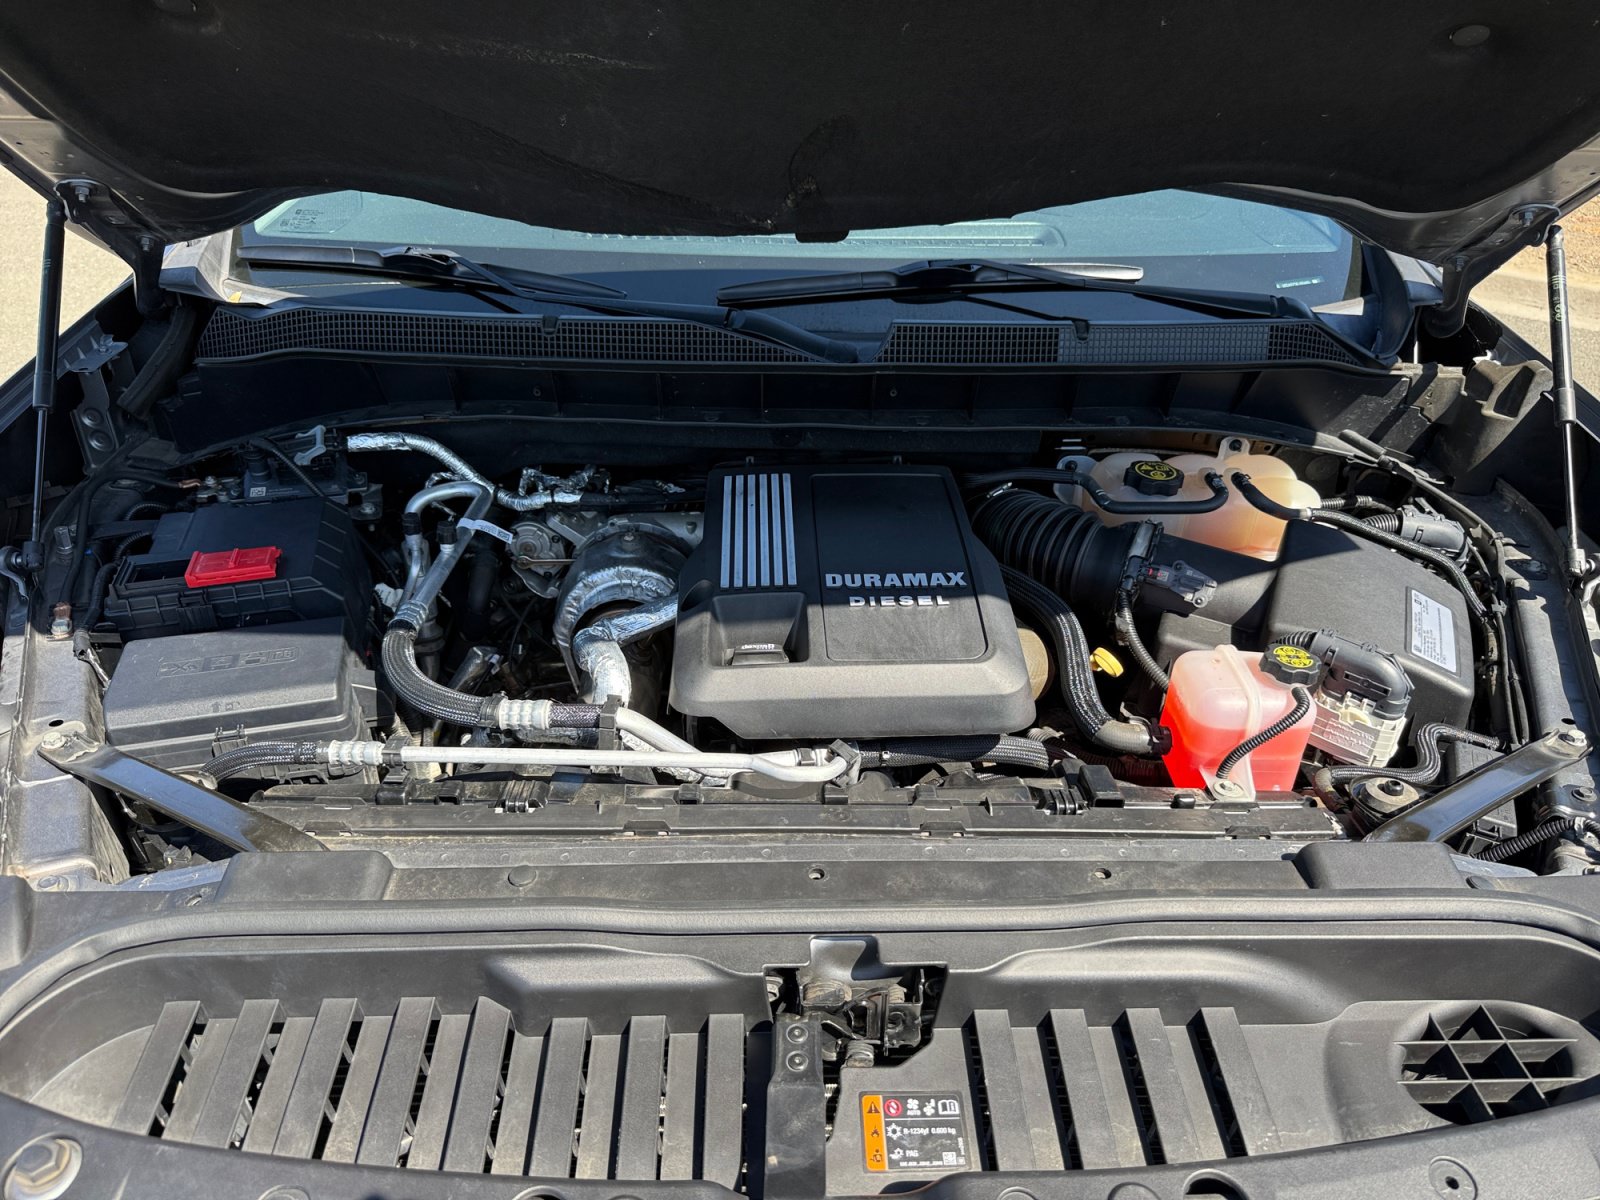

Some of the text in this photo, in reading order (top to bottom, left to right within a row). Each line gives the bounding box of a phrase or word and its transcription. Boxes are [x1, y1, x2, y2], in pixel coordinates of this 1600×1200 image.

[825, 571, 967, 588] DURAMAX
[849, 595, 950, 607] DIESEL
[903, 1127, 930, 1136] R-1234yf
[947, 1127, 957, 1135] kg
[906, 1149, 919, 1157] PAG
